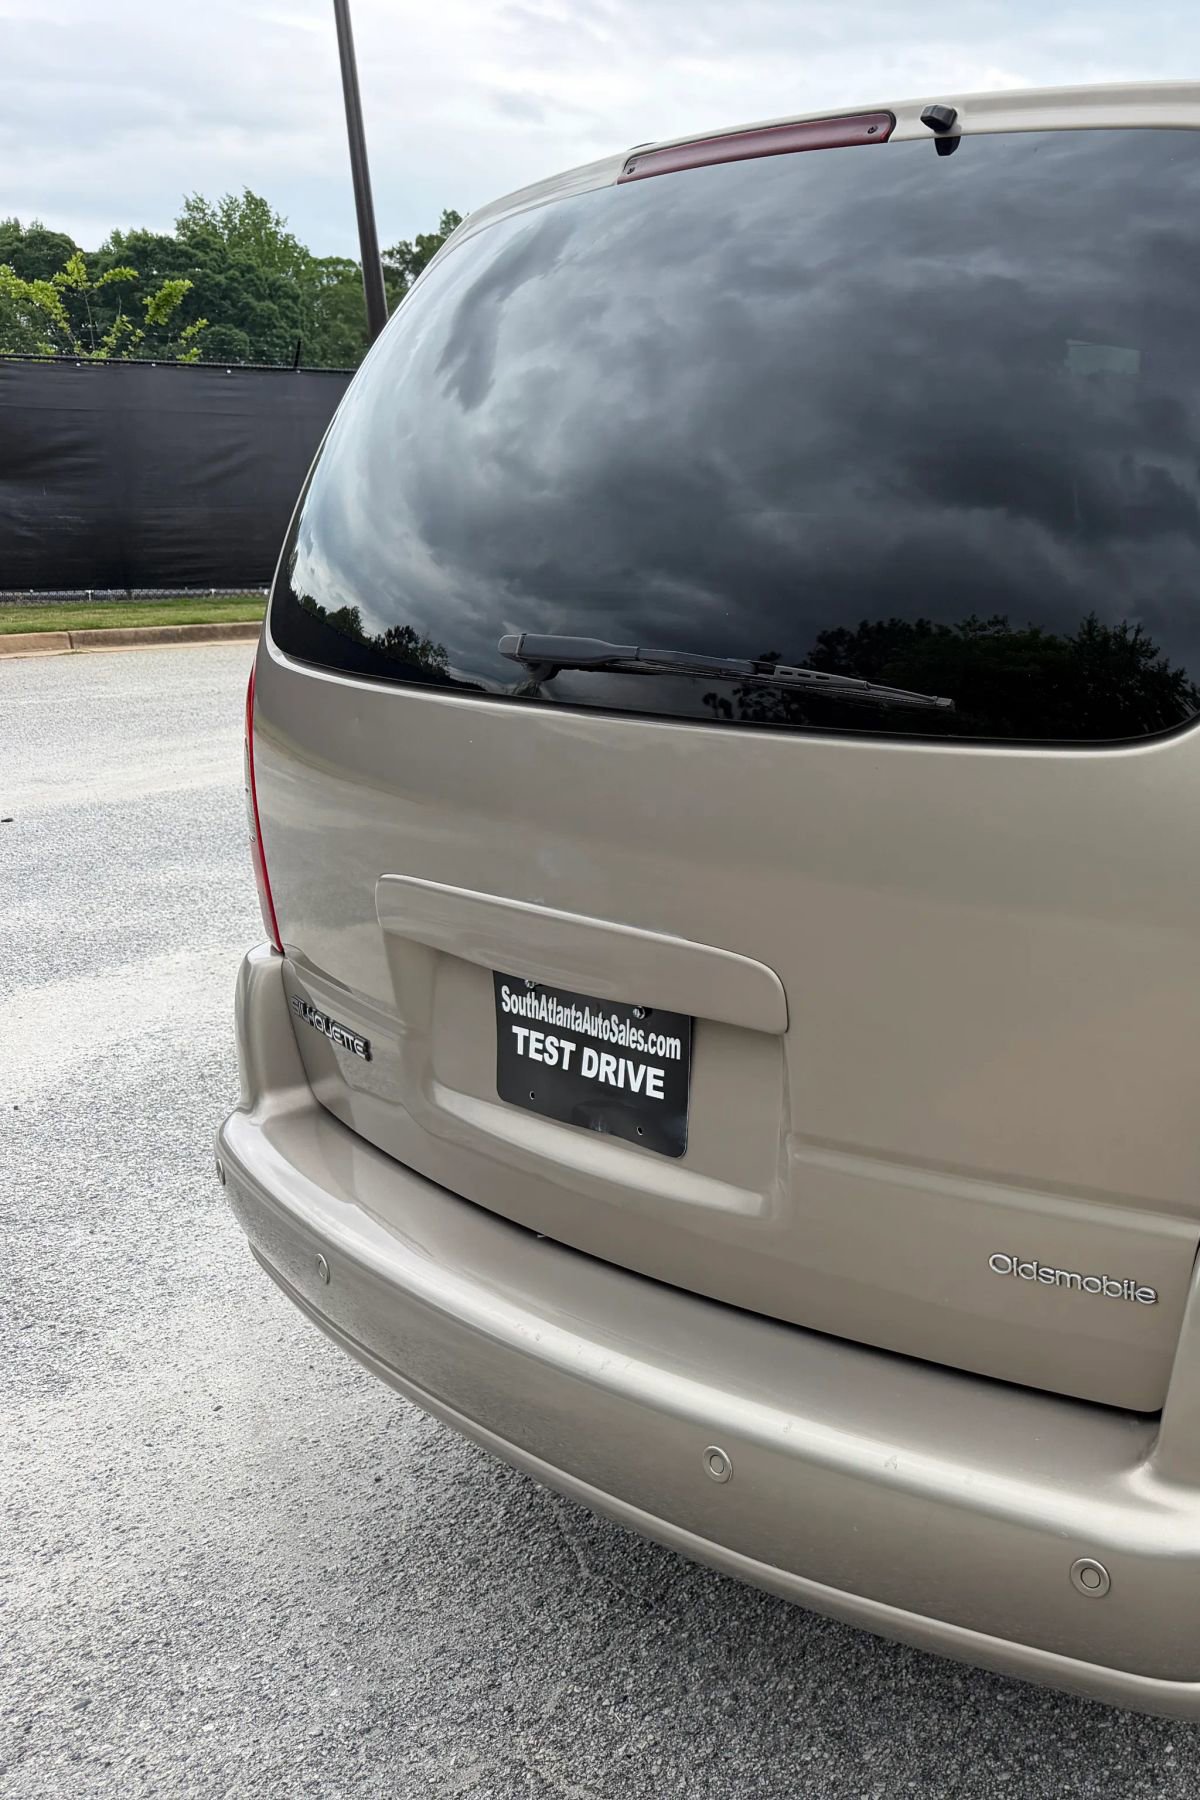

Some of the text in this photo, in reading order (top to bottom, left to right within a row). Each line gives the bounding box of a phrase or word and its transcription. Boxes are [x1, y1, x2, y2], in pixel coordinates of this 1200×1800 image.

[501, 985, 680, 1060] SouthAtlantaAutoSales.com
[512, 1025, 665, 1100] TEST DRIVE
[988, 1253, 1158, 1305] Oldsmobile
